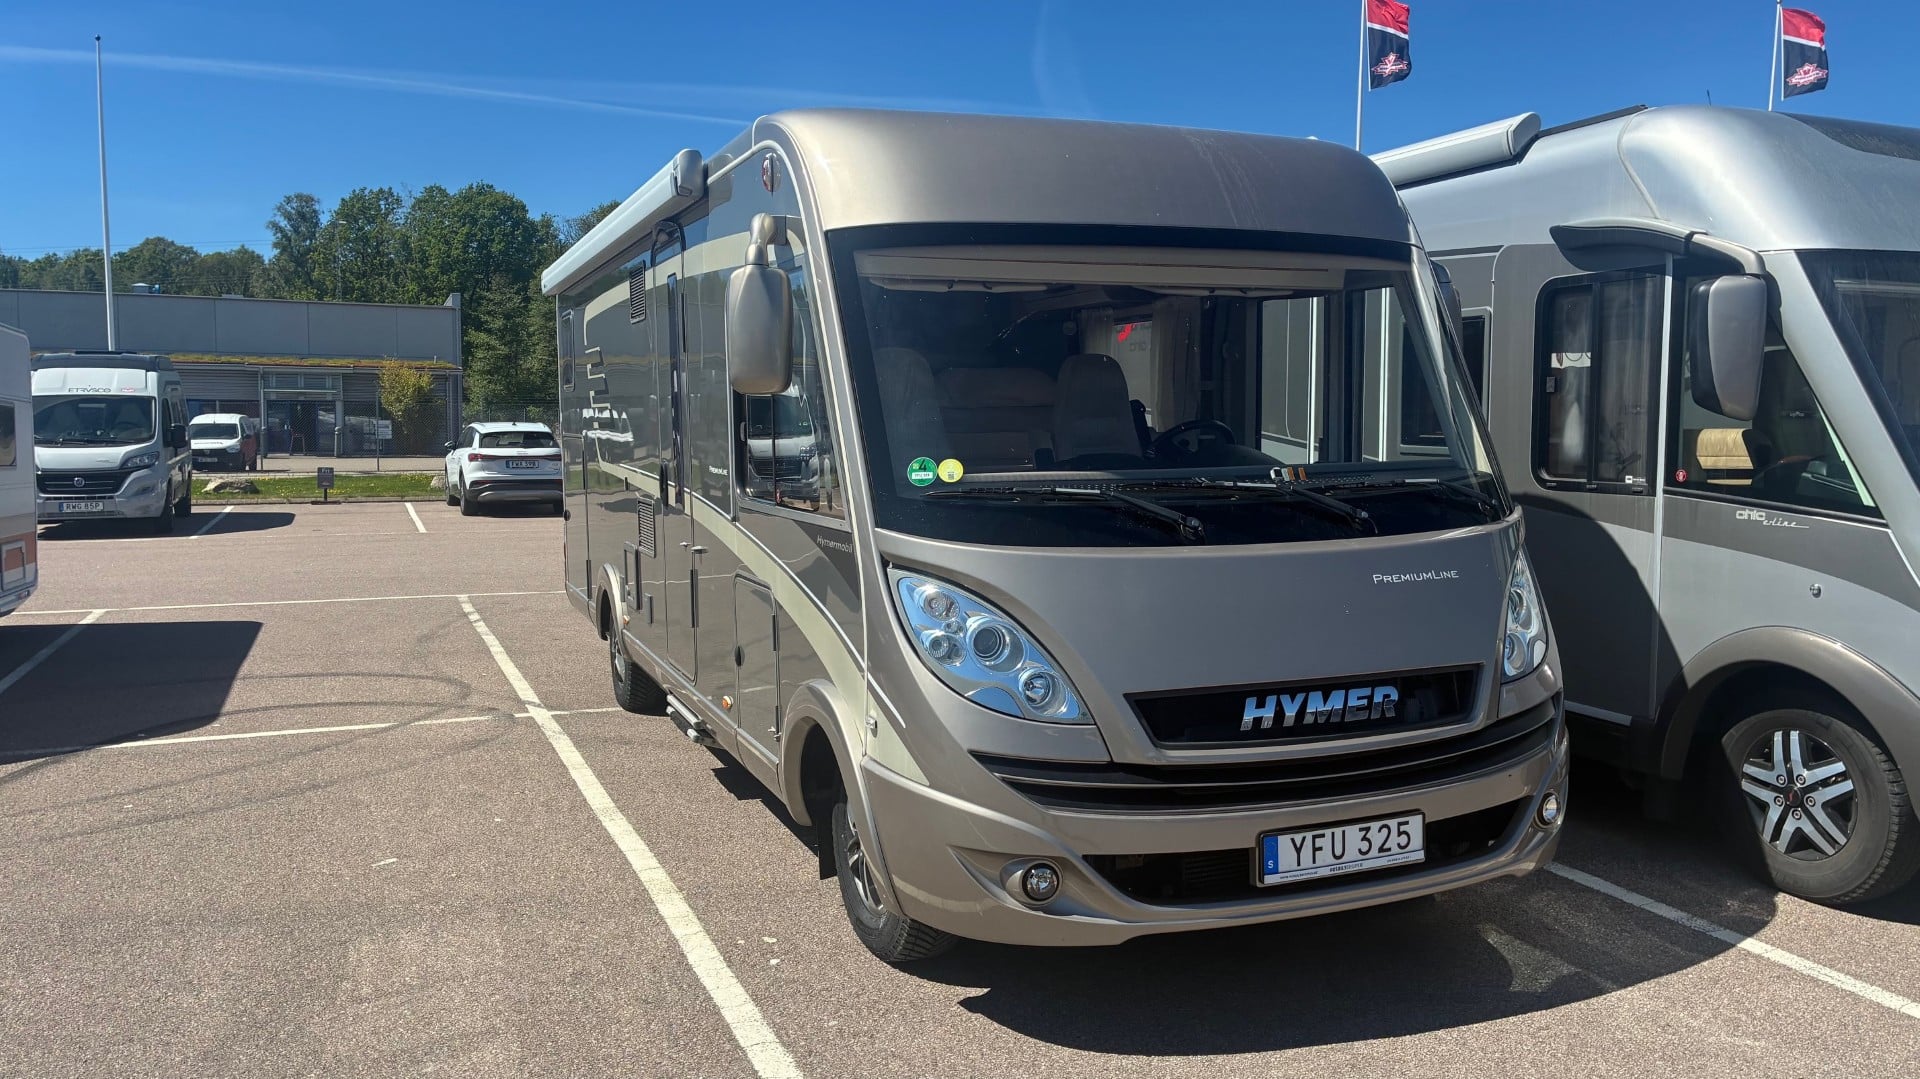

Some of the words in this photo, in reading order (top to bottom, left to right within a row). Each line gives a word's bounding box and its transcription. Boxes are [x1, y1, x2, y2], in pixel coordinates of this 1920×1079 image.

[919, 459, 927, 471] 4
[816, 535, 853, 553] Hymermobil
[1240, 685, 1399, 731] HYMER
[1267, 859, 1275, 869] S
[1290, 829, 1346, 867] YFU
[1357, 820, 1412, 856] 325
